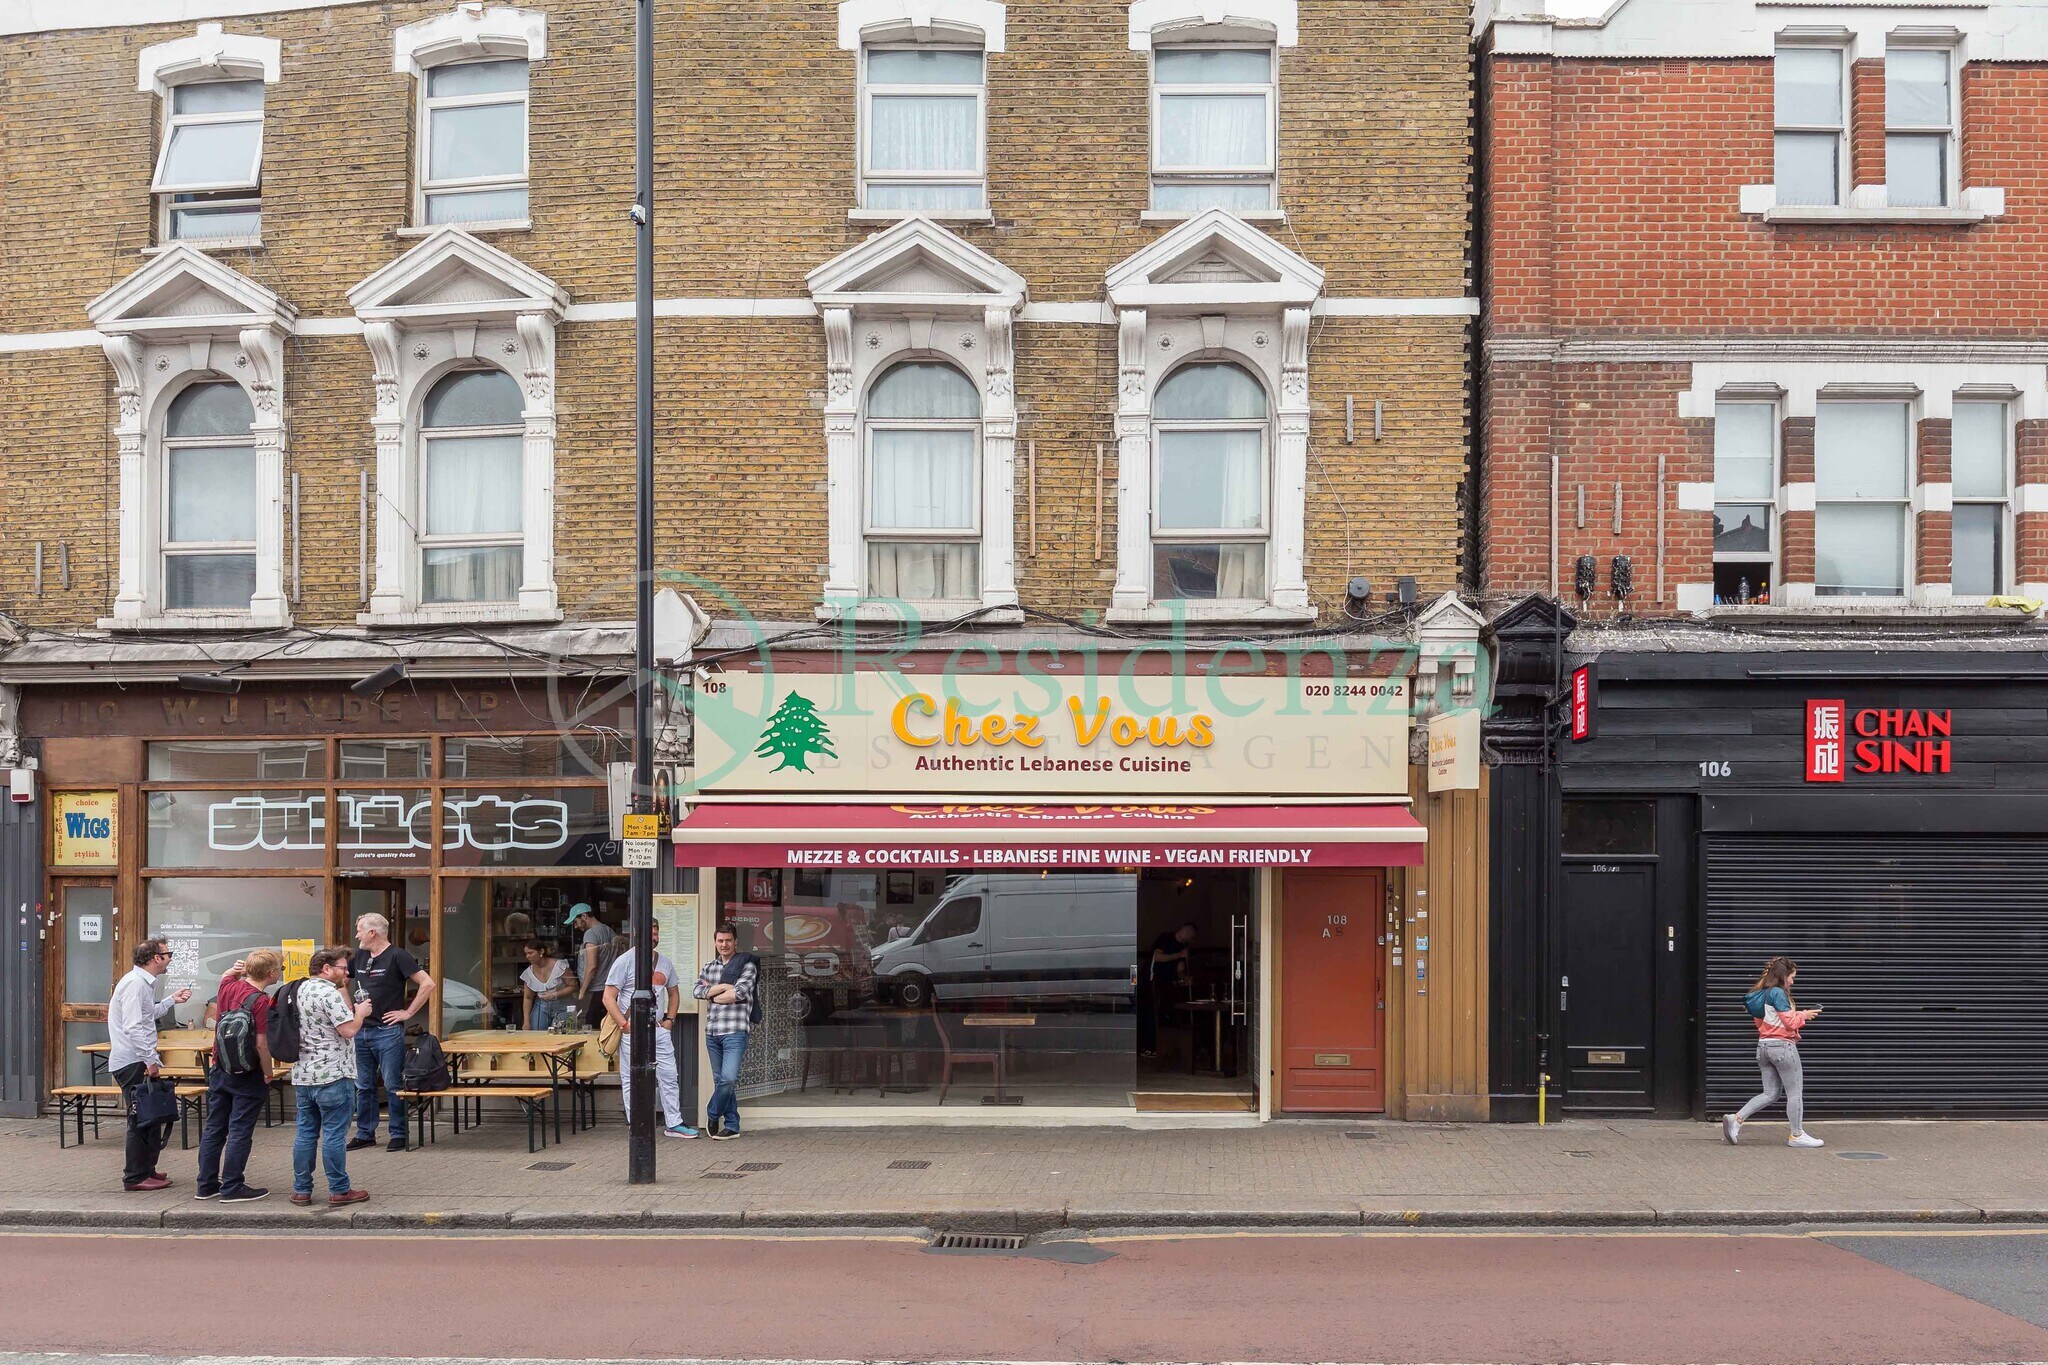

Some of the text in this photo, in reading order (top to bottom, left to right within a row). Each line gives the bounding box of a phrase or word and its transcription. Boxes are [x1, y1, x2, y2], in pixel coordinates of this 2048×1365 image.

[702, 682, 727, 694] 108
[1306, 685, 1403, 697] 020 8244 0042
[890, 692, 1215, 748] Chez Vous
[1853, 708, 1952, 737] CHAN
[1813, 706, 1840, 775] 振成
[915, 755, 1191, 772] Authentic Lebanese Cuisine
[1853, 740, 1952, 774] SINH
[1699, 760, 1731, 777] 106
[75, 798, 99, 806] choice
[909, 812, 1012, 820] Authentic
[1121, 812, 1195, 820] Cuisine
[110, 797, 118, 860] comfortable
[74, 851, 100, 859] stylish
[787, 849, 843, 865] MEZZE
[846, 849, 862, 865] &
[865, 849, 959, 865] COCKTAILS
[973, 849, 1057, 864] LEBANESE
[1062, 849, 1100, 864] FINE
[1104, 849, 1151, 864] WINE
[1165, 849, 1224, 864] VEGAN
[1229, 849, 1312, 864] FRIENDLY
[1592, 864, 1607, 873] 106
[1327, 915, 1348, 925] 108
[1322, 928, 1331, 938] A
